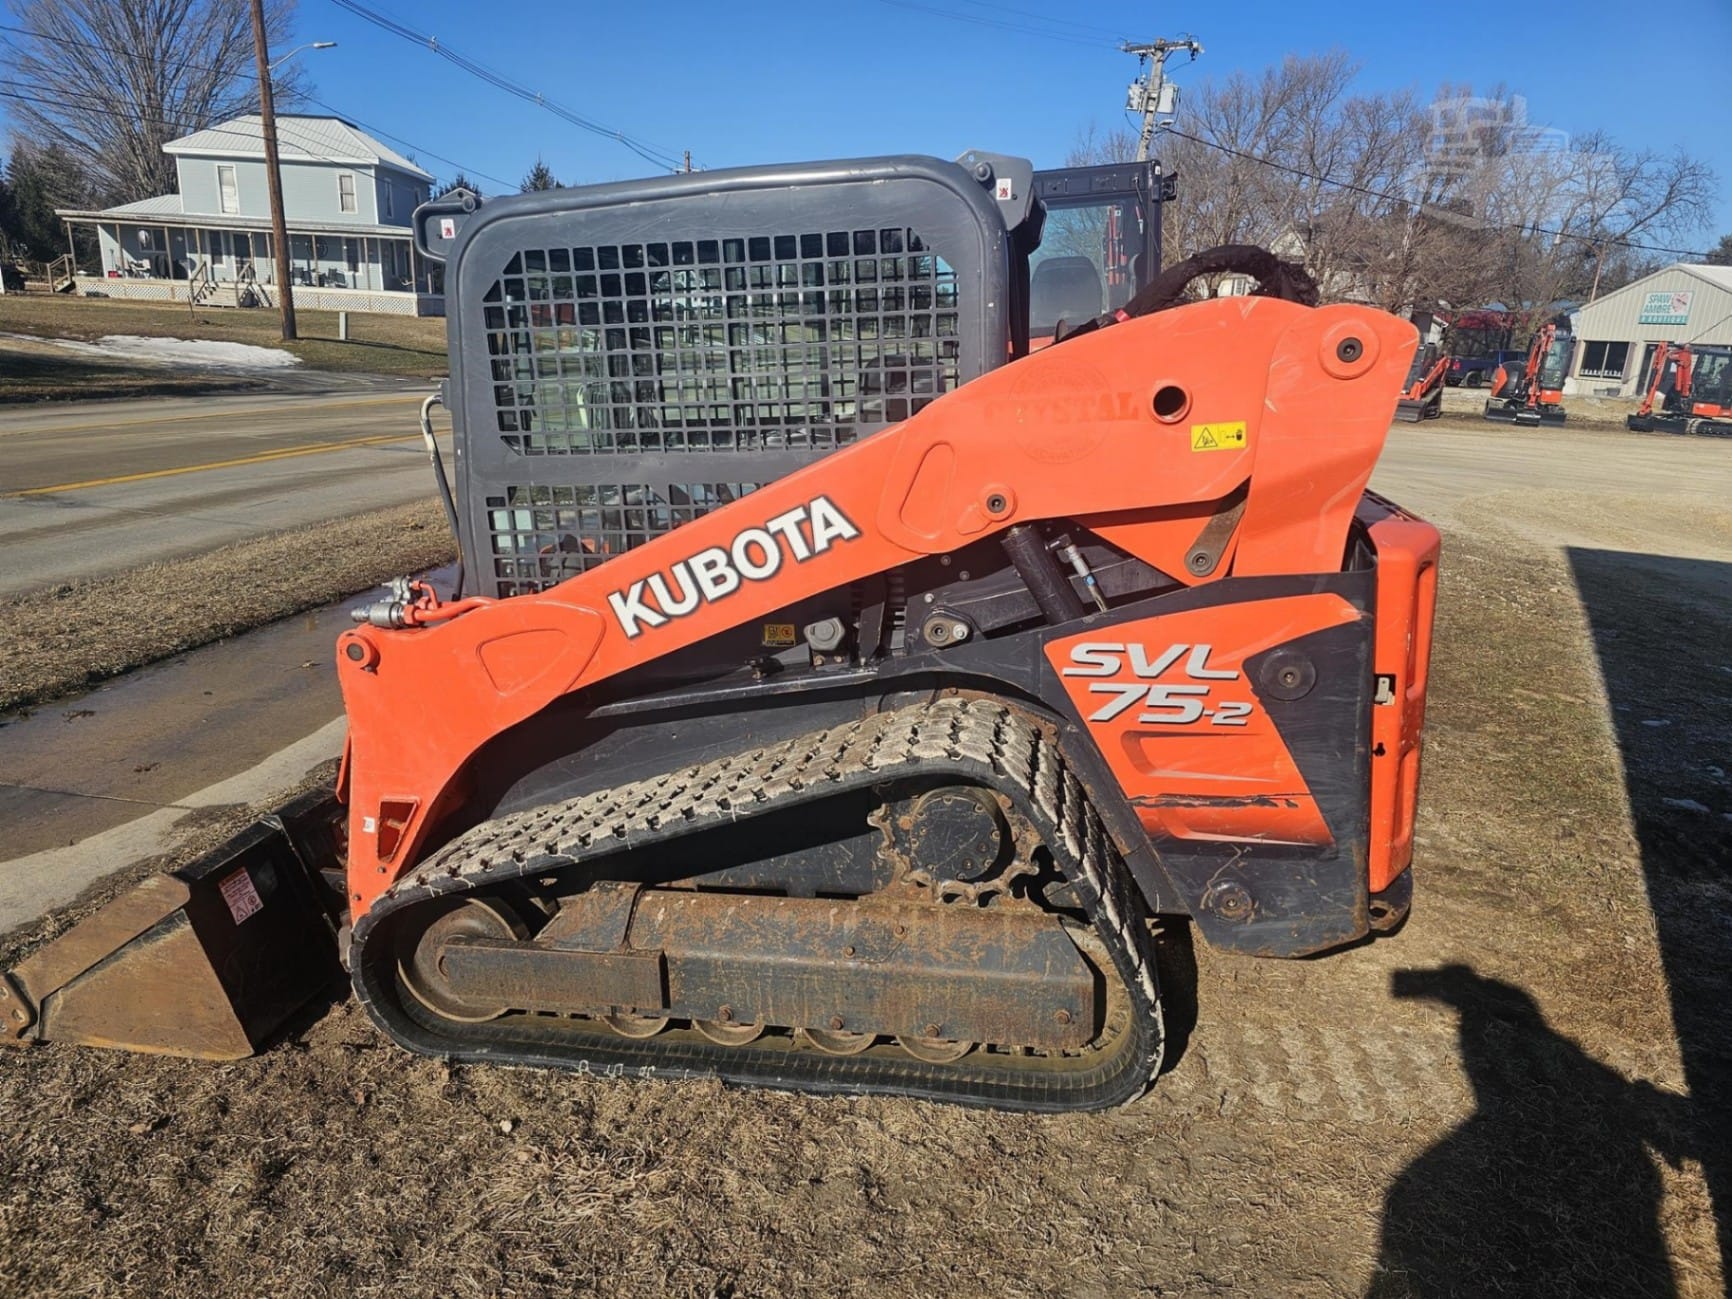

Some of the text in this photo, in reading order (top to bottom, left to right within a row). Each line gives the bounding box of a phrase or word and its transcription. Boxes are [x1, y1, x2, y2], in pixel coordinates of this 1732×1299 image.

[607, 495, 862, 640] KUBOTA
[1062, 642, 1240, 680] SVL
[1088, 682, 1253, 726] 75-2
